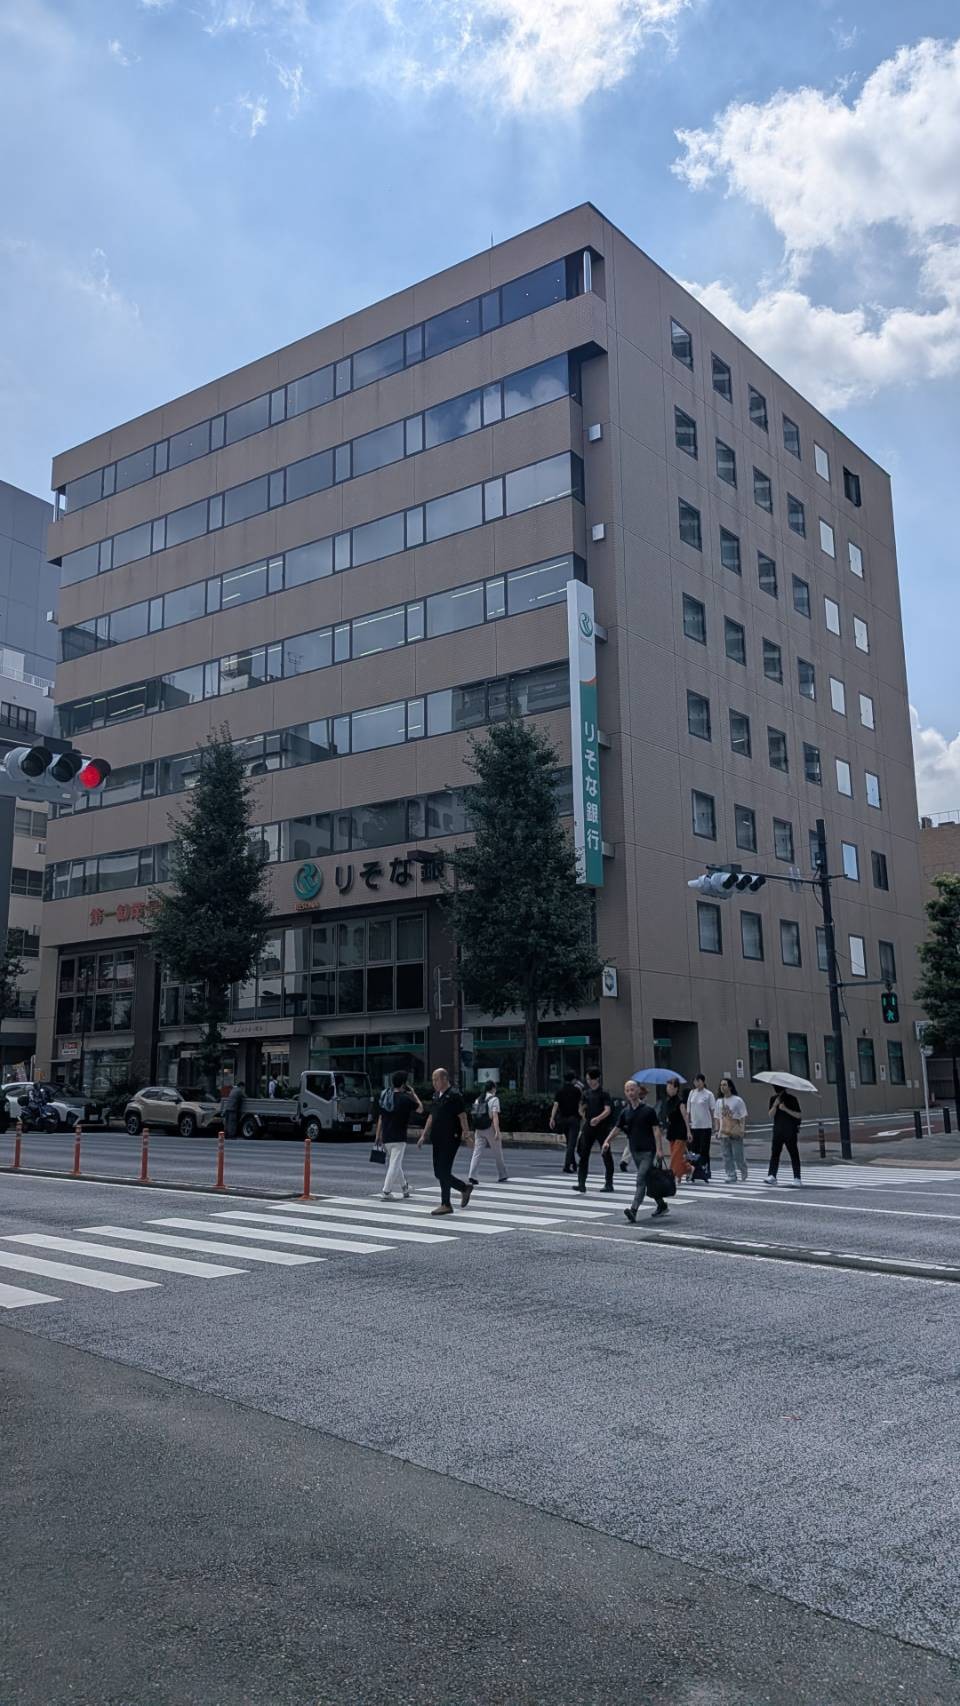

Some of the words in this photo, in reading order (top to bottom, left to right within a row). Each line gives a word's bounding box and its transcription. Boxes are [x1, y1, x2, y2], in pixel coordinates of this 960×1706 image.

[584, 721, 599, 851] りそな銀行
